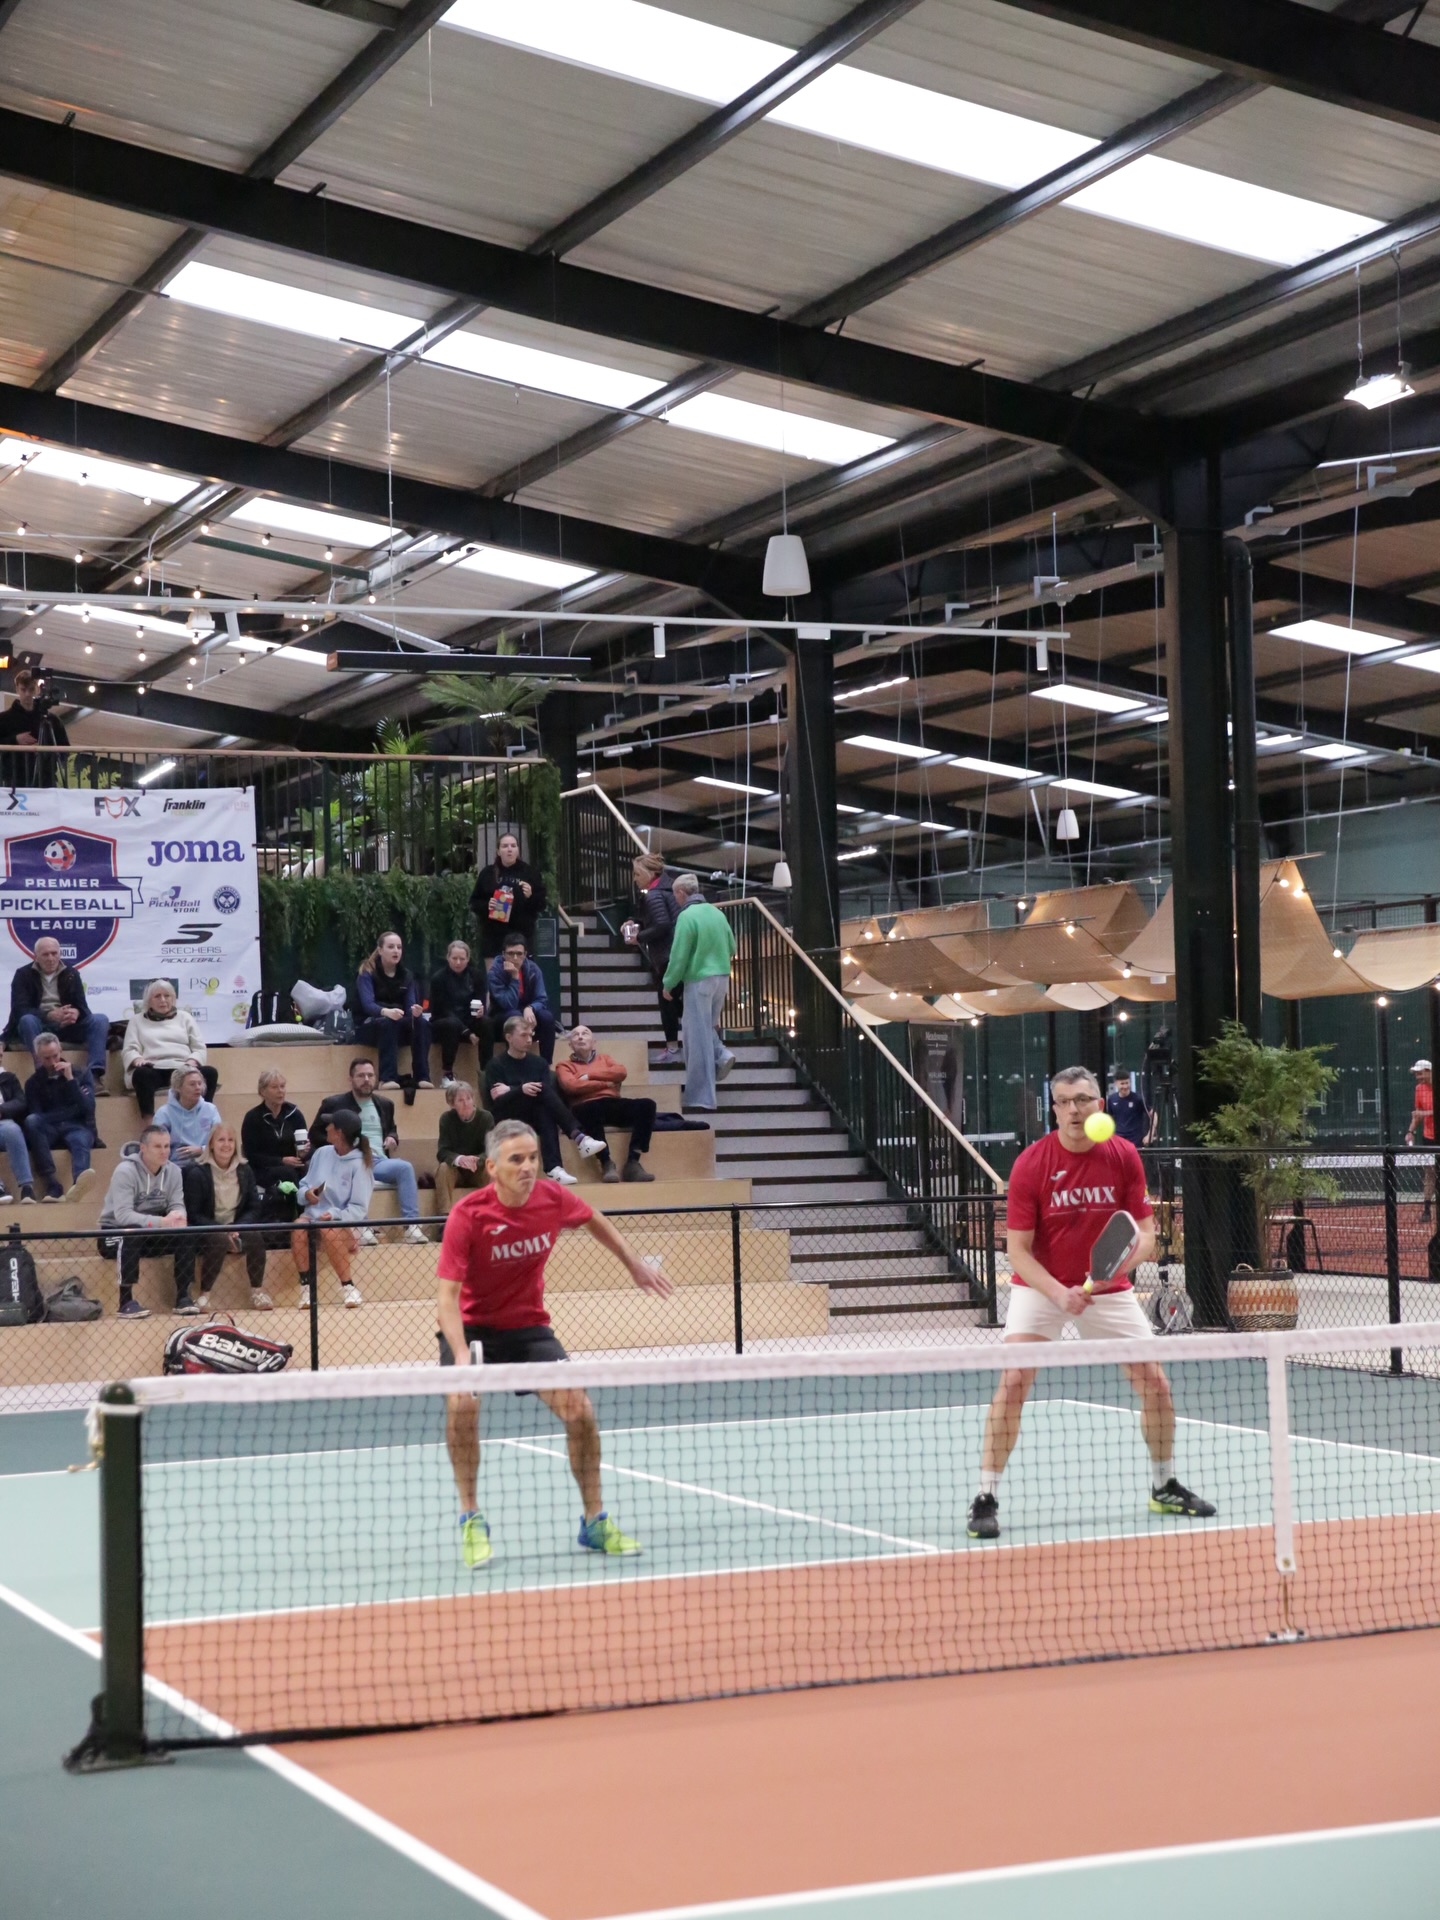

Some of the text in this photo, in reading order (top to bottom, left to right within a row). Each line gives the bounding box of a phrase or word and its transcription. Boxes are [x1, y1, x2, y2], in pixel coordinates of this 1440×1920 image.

[25, 878, 100, 888] PREMIER
[0, 898, 126, 911] PICKLEBALL
[30, 920, 97, 930] LEAGUE
[161, 947, 222, 955] SKECHERS
[1050, 1186, 1116, 1208] MCMX
[490, 1232, 551, 1261] MCMX
[10, 1257, 20, 1303] HEAD
